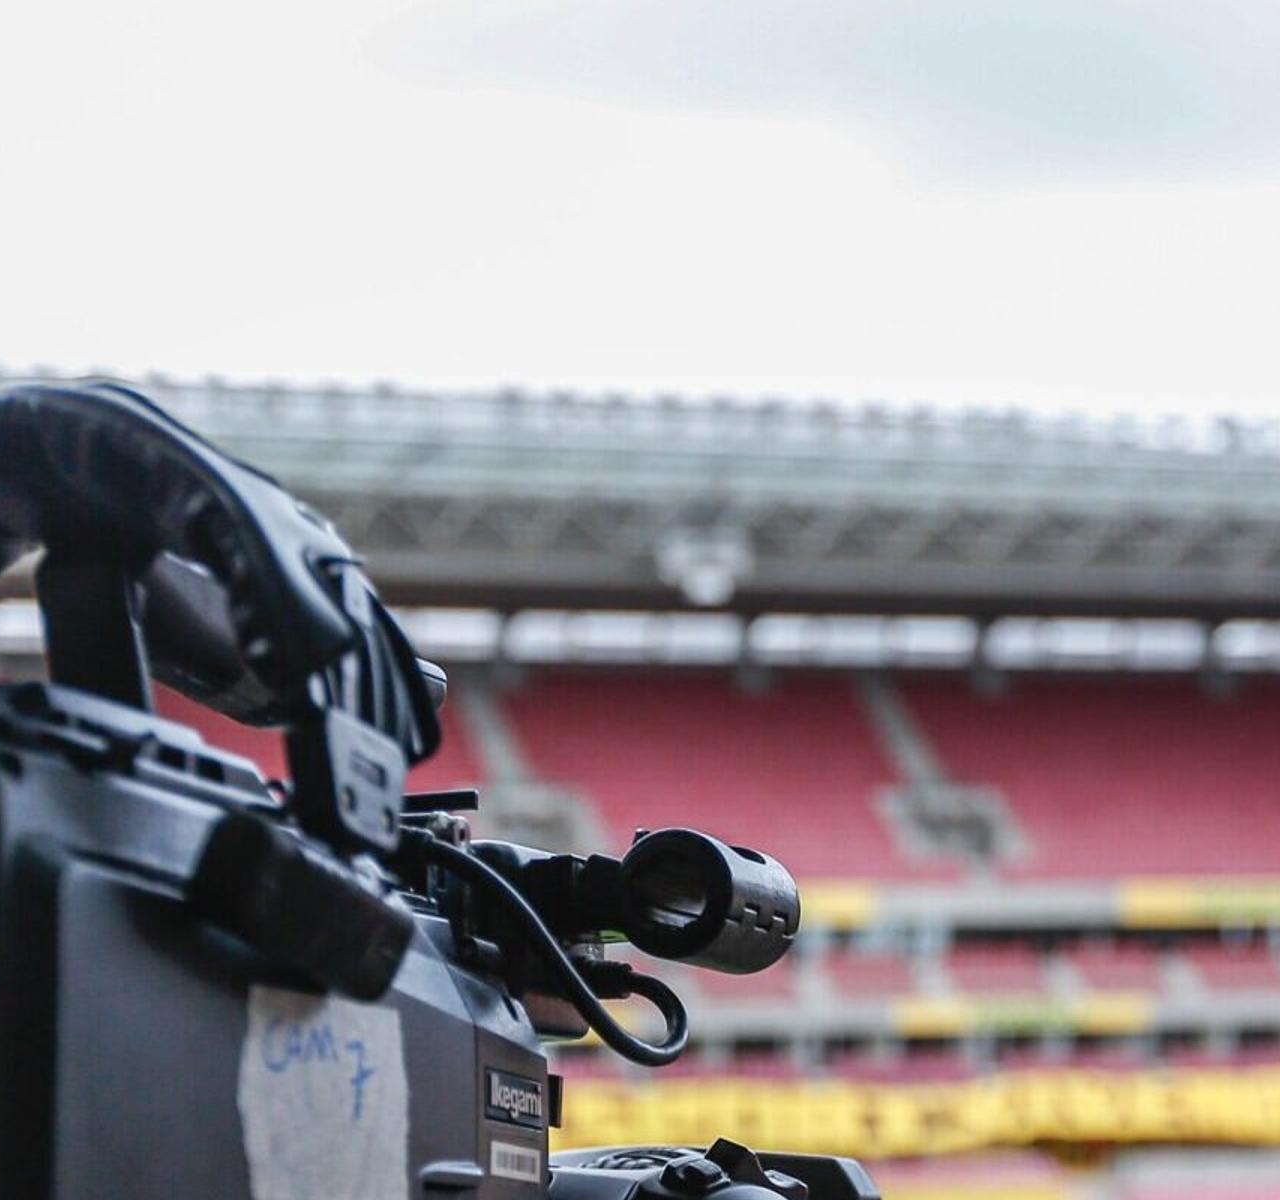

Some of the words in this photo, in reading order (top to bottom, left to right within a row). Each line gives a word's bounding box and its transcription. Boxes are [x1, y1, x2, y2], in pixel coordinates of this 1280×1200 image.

[261, 1018, 339, 1073] CAM
[346, 1041, 376, 1119] 7
[491, 1072, 542, 1118] Ikegami
